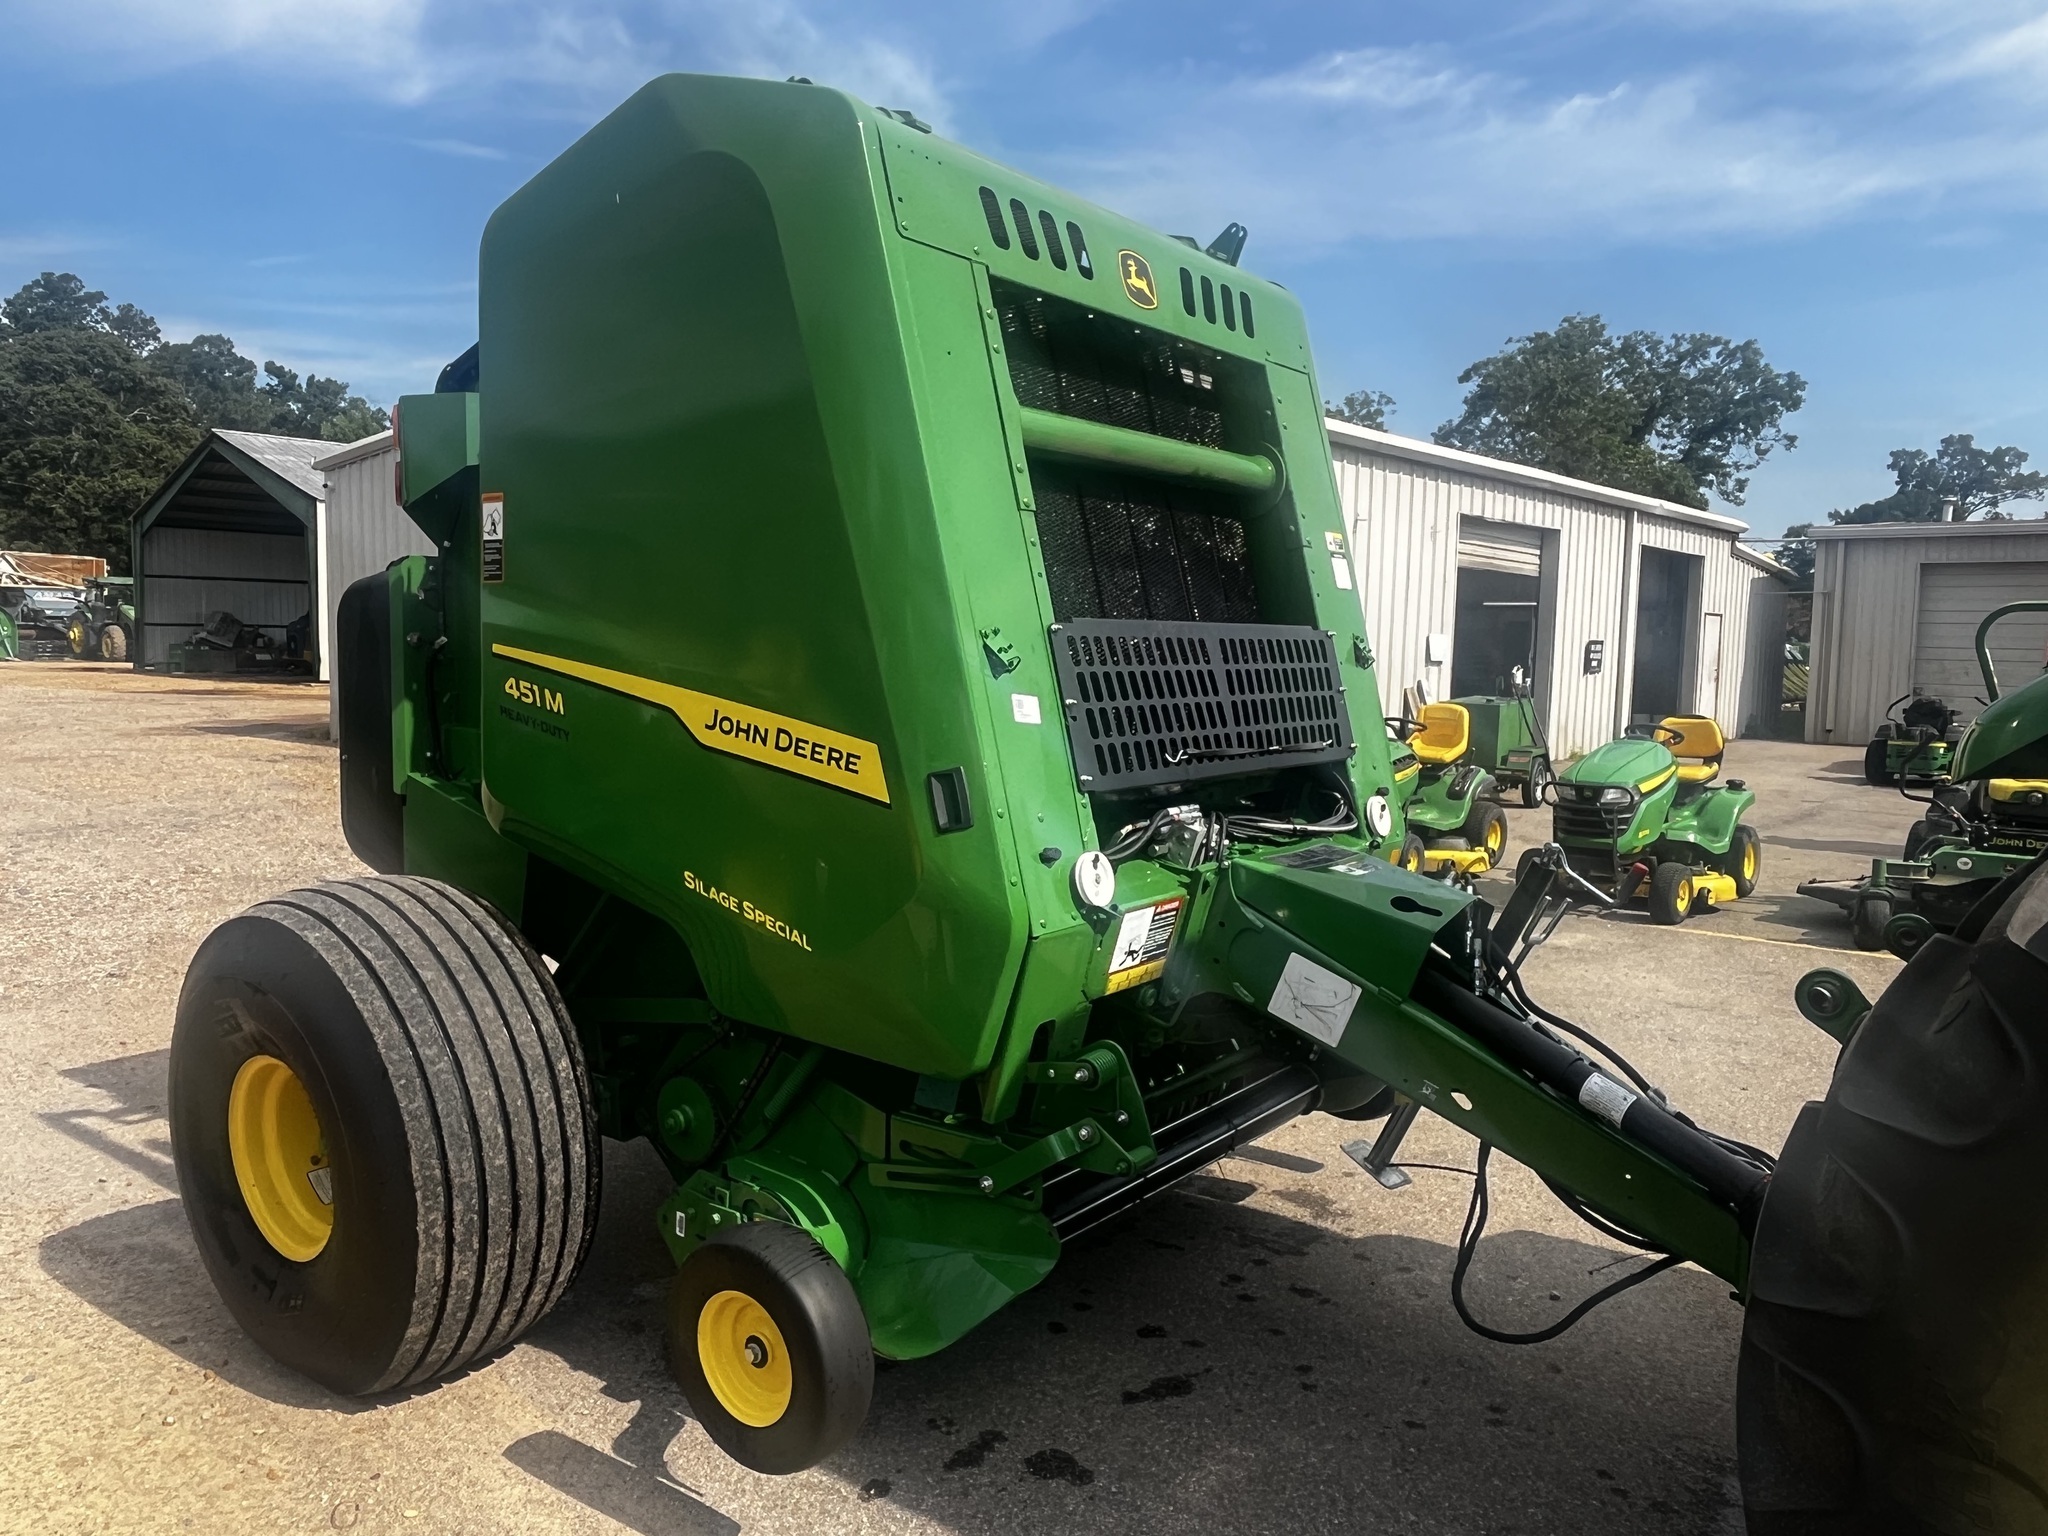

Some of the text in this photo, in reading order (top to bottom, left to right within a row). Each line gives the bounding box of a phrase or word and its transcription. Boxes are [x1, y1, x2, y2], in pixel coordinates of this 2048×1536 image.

[500, 705, 570, 742] HEAVY-DUTY
[704, 709, 861, 775] JOHN DEERE
[1989, 836, 2023, 847] JOHN
[683, 870, 812, 952] SILAGE SPECIAL
